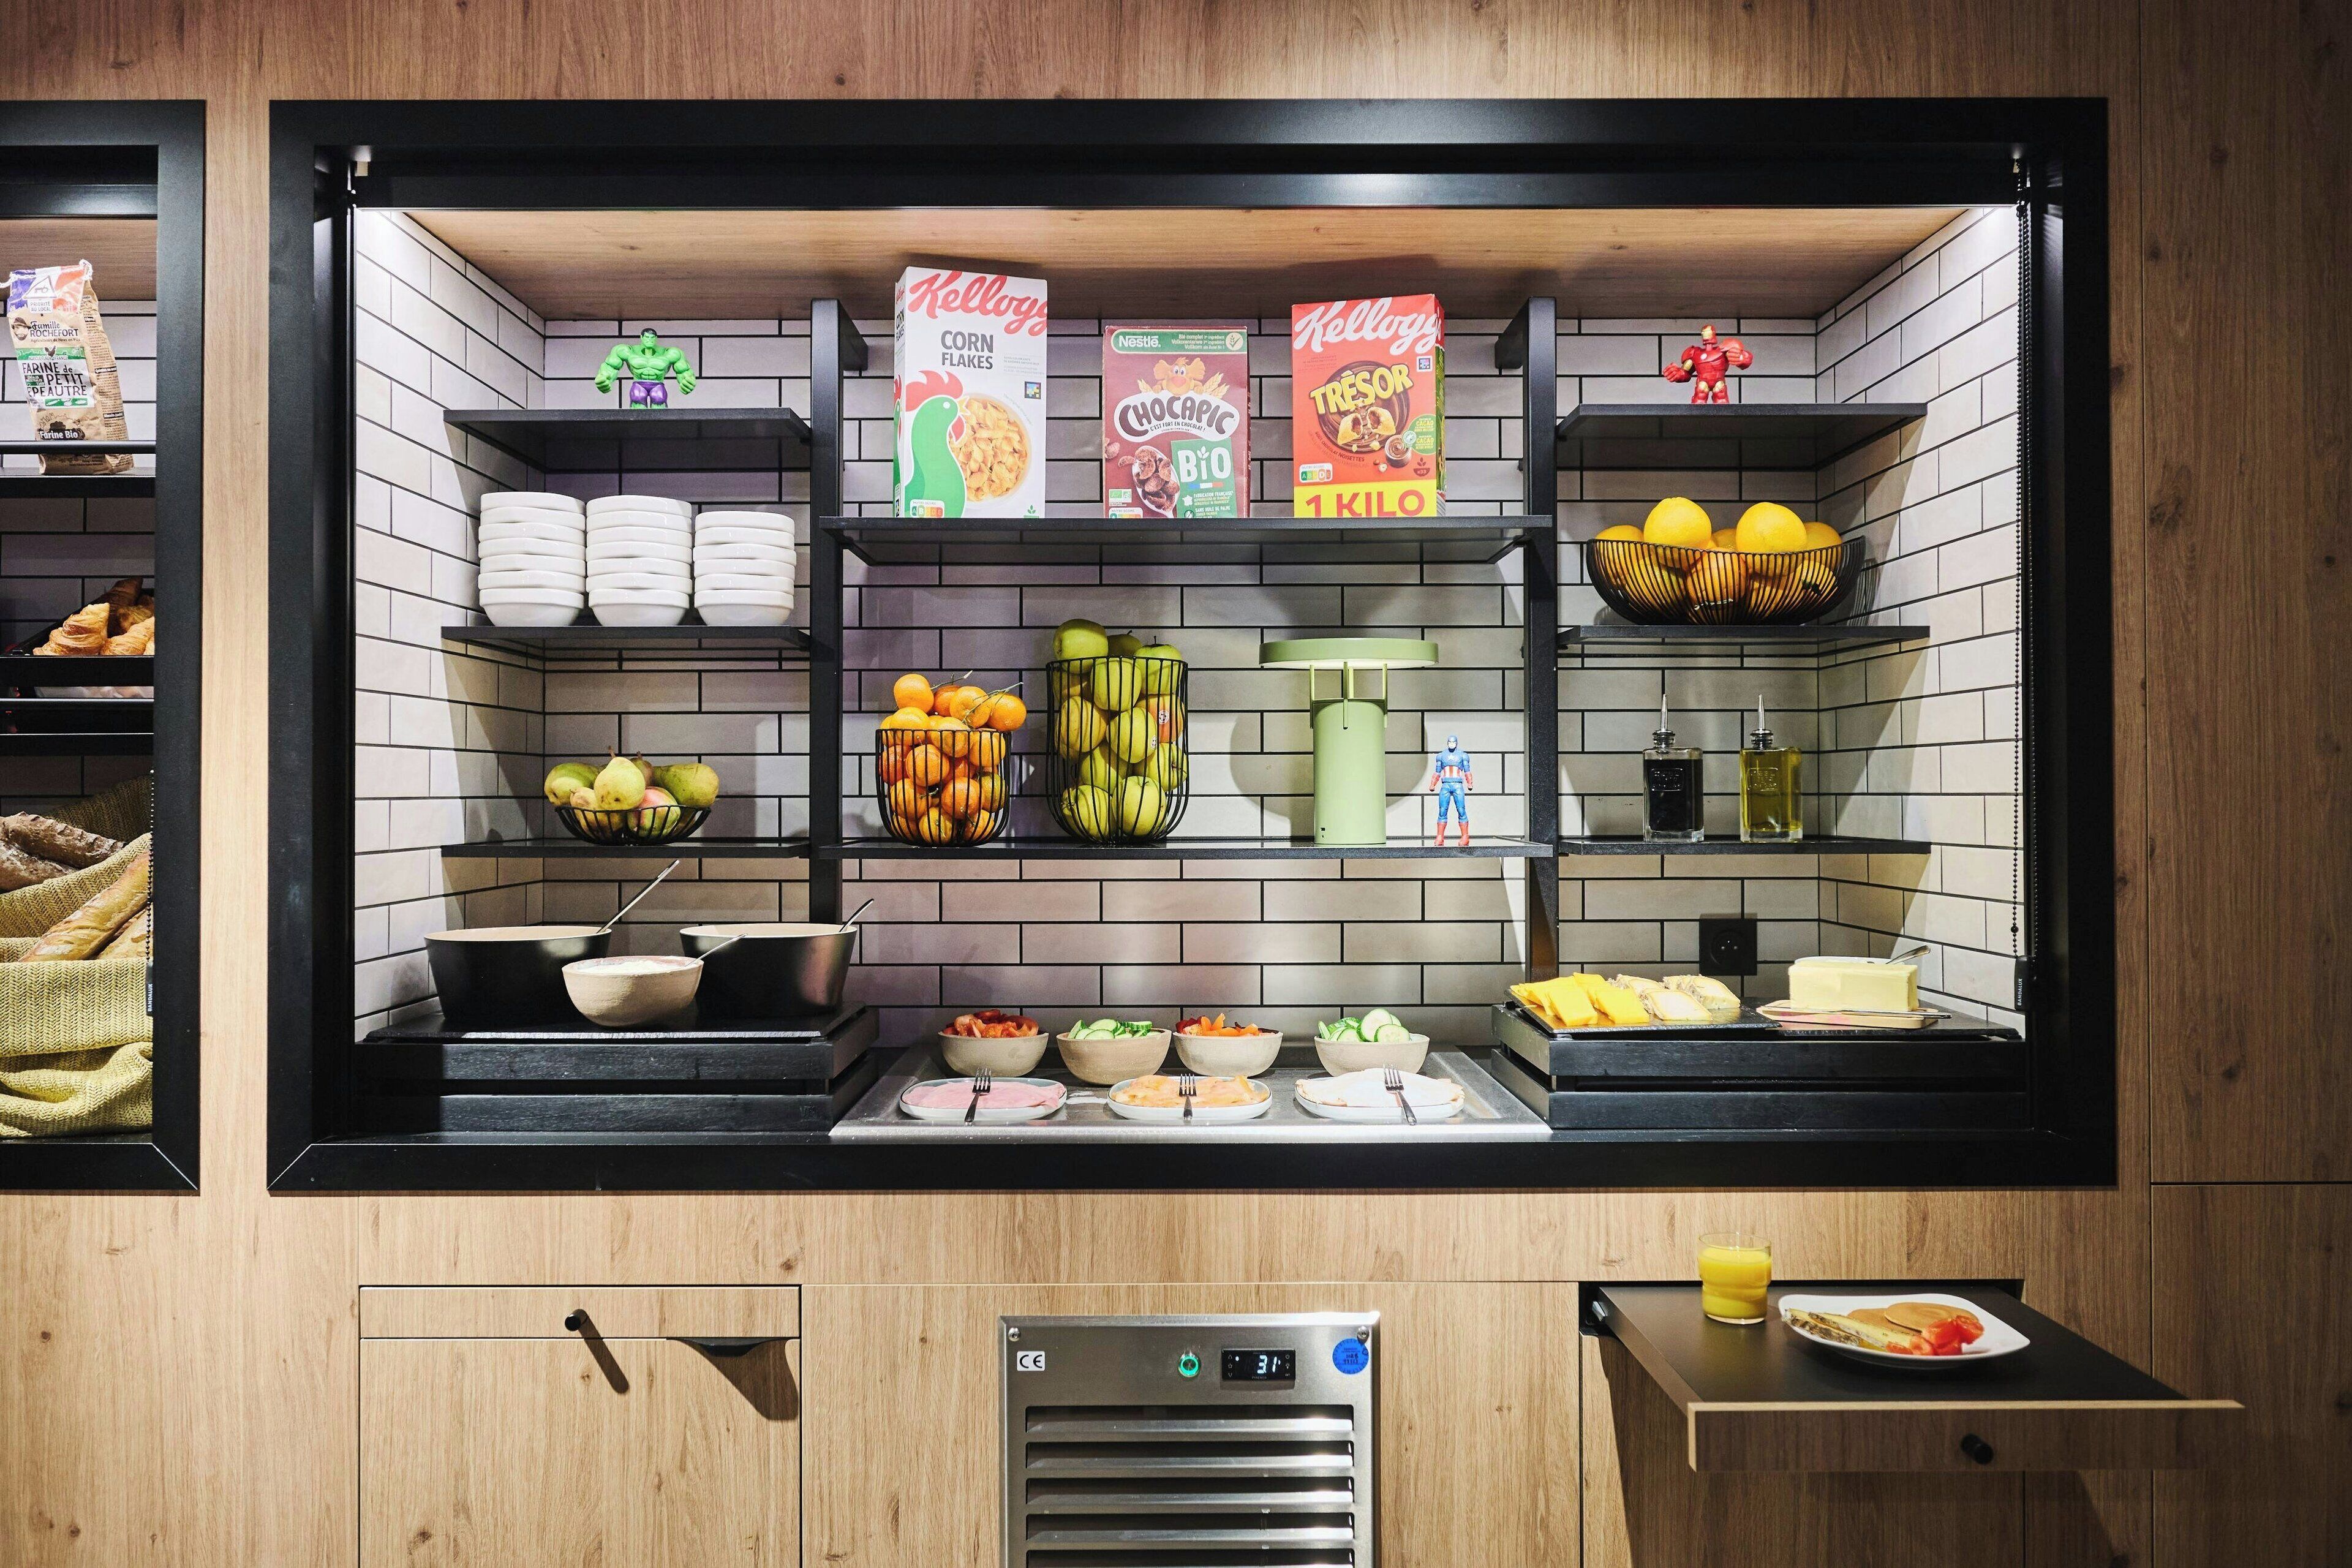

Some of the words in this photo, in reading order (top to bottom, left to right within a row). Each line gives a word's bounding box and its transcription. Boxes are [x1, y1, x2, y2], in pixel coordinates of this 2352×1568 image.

[31, 320, 60, 330] Famille
[941, 330, 993, 353] CORN
[942, 352, 993, 369] FLAKES
[22, 362, 60, 374] FARINE
[63, 364, 73, 373] de
[46, 374, 83, 385] PETIT
[1310, 364, 1414, 415] TRÉSOR
[1119, 396, 1235, 437] CHOCAPIC
[1181, 421, 1203, 431] CHOCOLAT
[39, 430, 64, 439] Farine
[65, 430, 78, 439] Bio
[1338, 453, 1365, 462] NOISETTES
[1306, 494, 1321, 517] 1
[1336, 489, 1425, 517] KILO
[1019, 1354, 1042, 1368] CE
